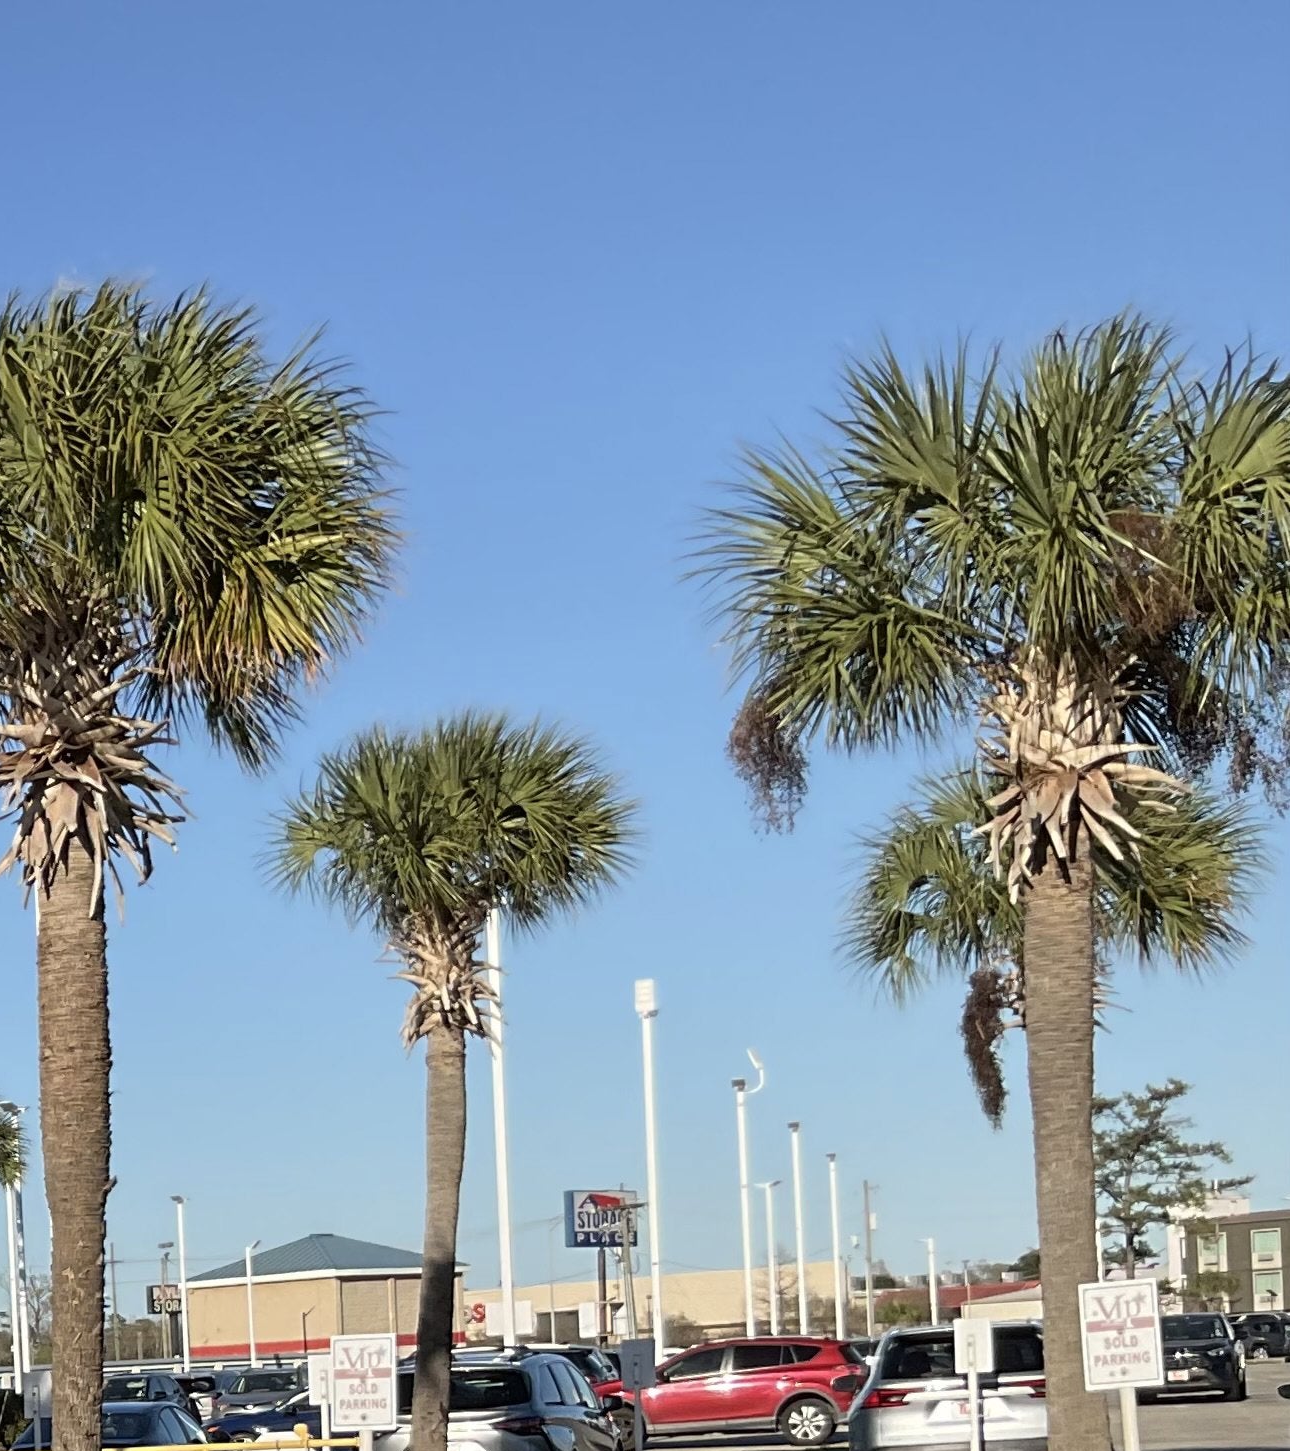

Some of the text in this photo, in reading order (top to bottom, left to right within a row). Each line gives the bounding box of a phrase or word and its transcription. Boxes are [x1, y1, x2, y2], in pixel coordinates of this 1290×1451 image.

[577, 1232, 635, 1243] PLACE
[1104, 1335, 1138, 1350] SOLD
[1093, 1351, 1151, 1367] PARKING
[348, 1383, 378, 1395] SOLD
[339, 1399, 387, 1410] PARKING
